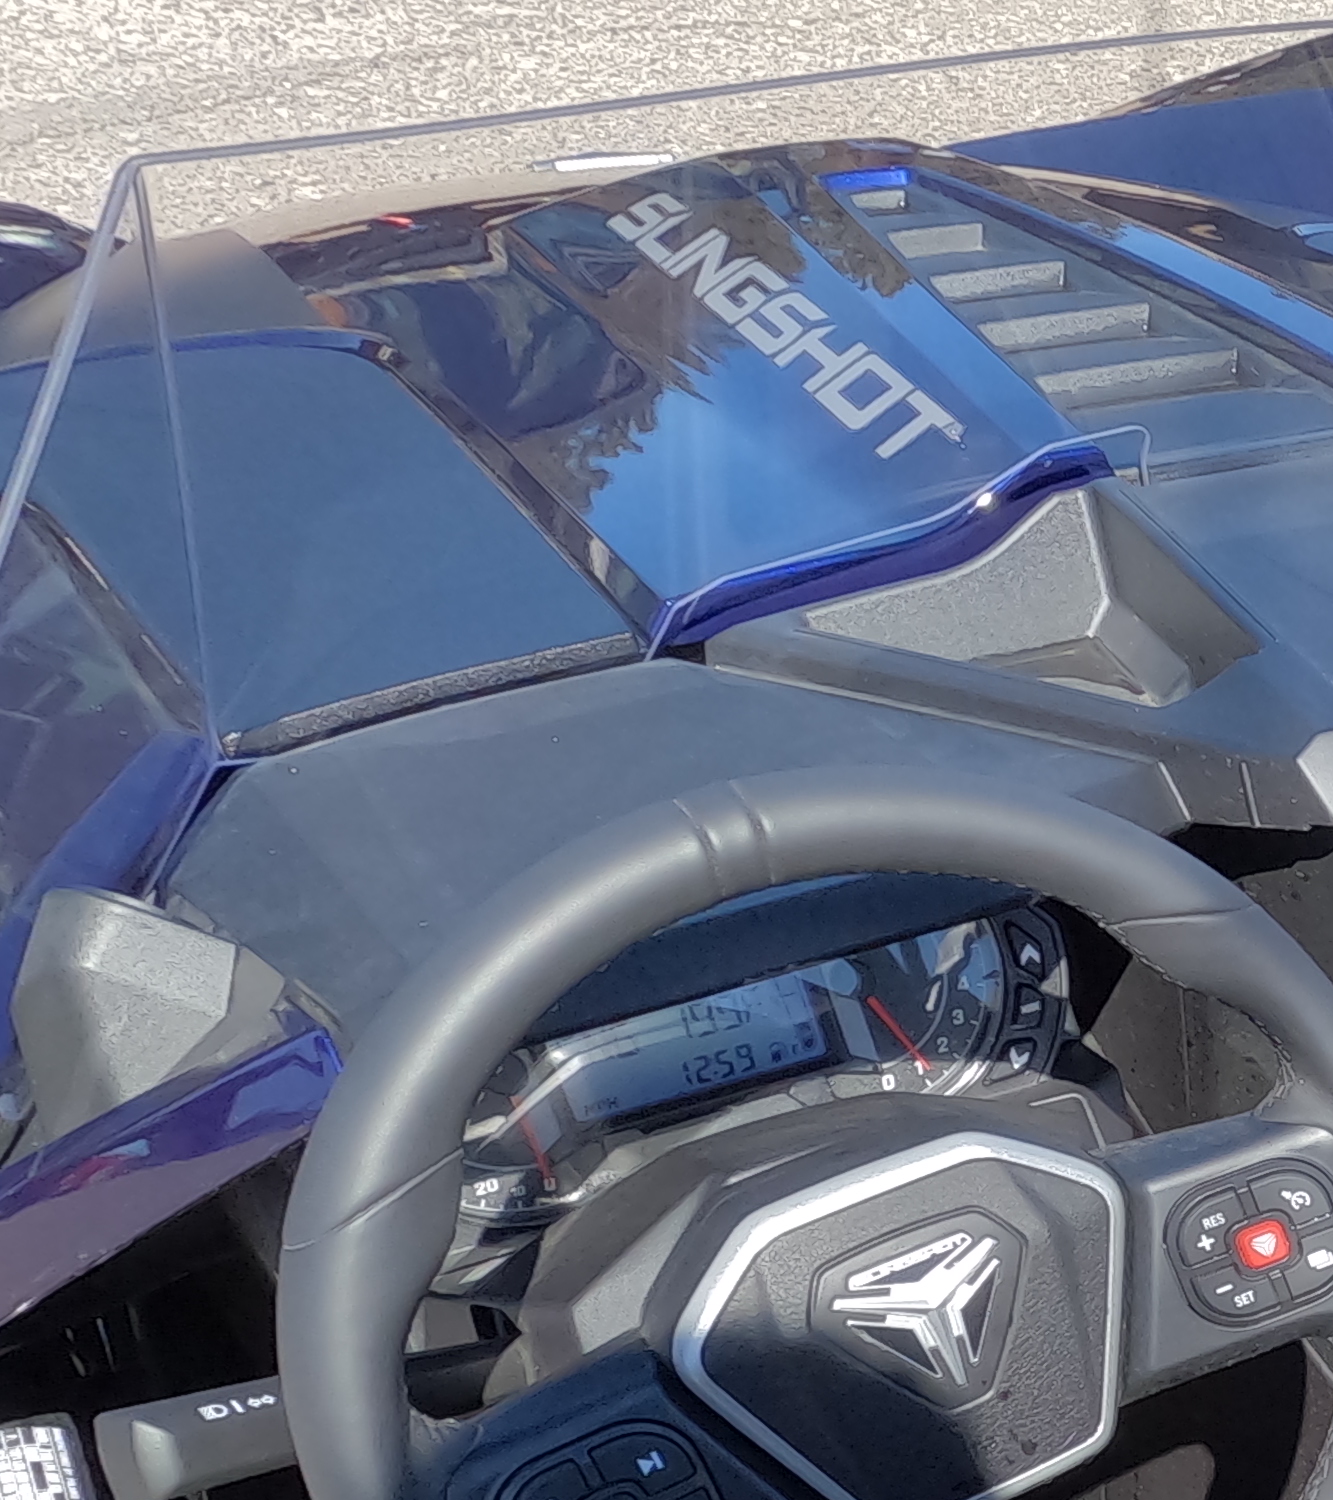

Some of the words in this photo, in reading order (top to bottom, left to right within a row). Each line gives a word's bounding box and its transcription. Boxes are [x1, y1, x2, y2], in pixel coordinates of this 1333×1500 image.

[605, 192, 968, 460] SLINGSHOT
[952, 1009, 964, 1025] 3
[937, 1037, 949, 1053] 2
[881, 1074, 896, 1091] 0
[473, 1178, 499, 1196] 20
[1202, 1212, 1226, 1230] RES
[1234, 1290, 1256, 1308] SET
